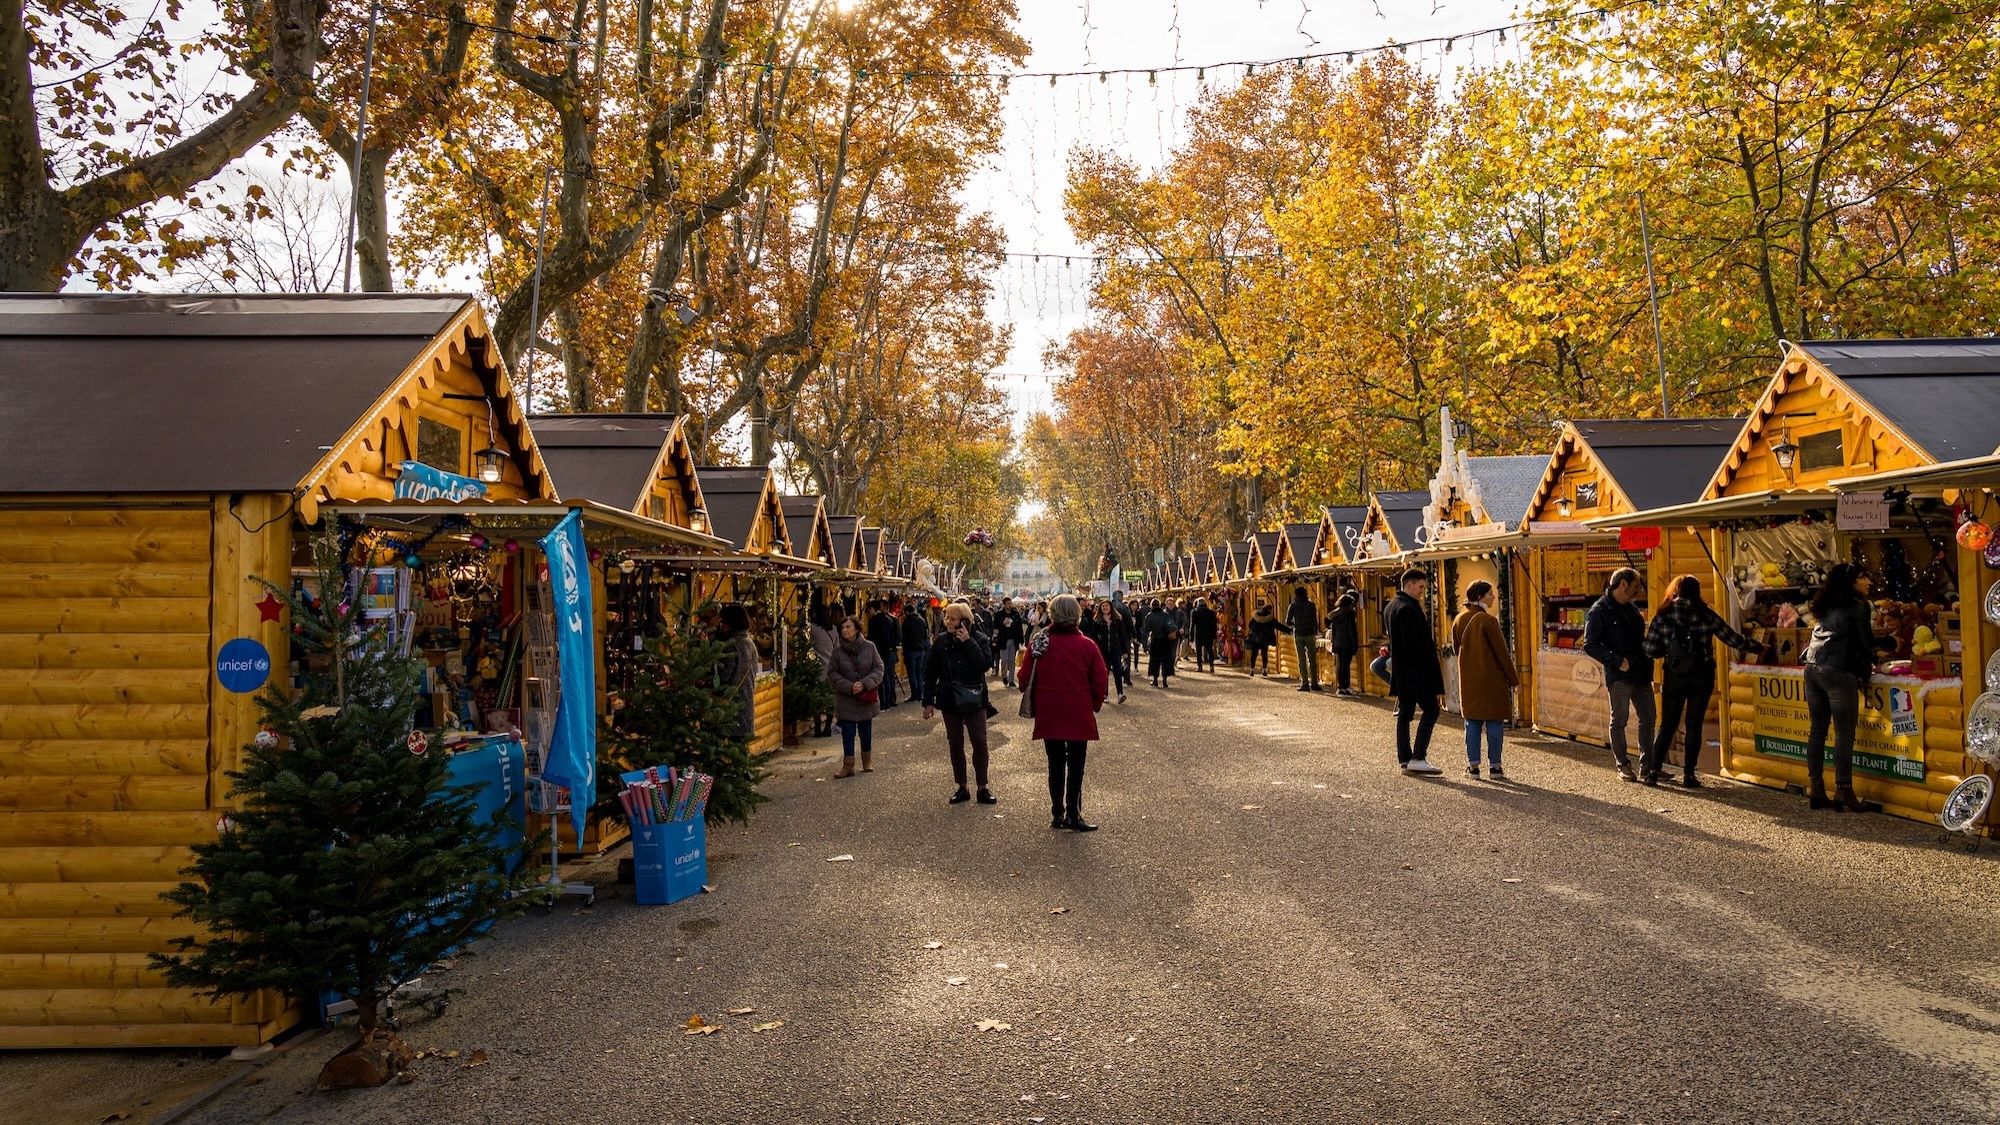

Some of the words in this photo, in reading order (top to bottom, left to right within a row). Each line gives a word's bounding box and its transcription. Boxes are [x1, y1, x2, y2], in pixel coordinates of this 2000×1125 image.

[218, 659, 253, 671] unicef
[1756, 706, 1787, 718] PELUCHES
[1892, 722, 1917, 734] FRANCE
[1880, 743, 1910, 753] CHALEUR
[1767, 740, 1800, 754] BOUILLOTTE
[1862, 755, 1888, 770] PLANTÉ
[1903, 768, 1924, 779] FUTURE
[675, 850, 694, 866] unicef
